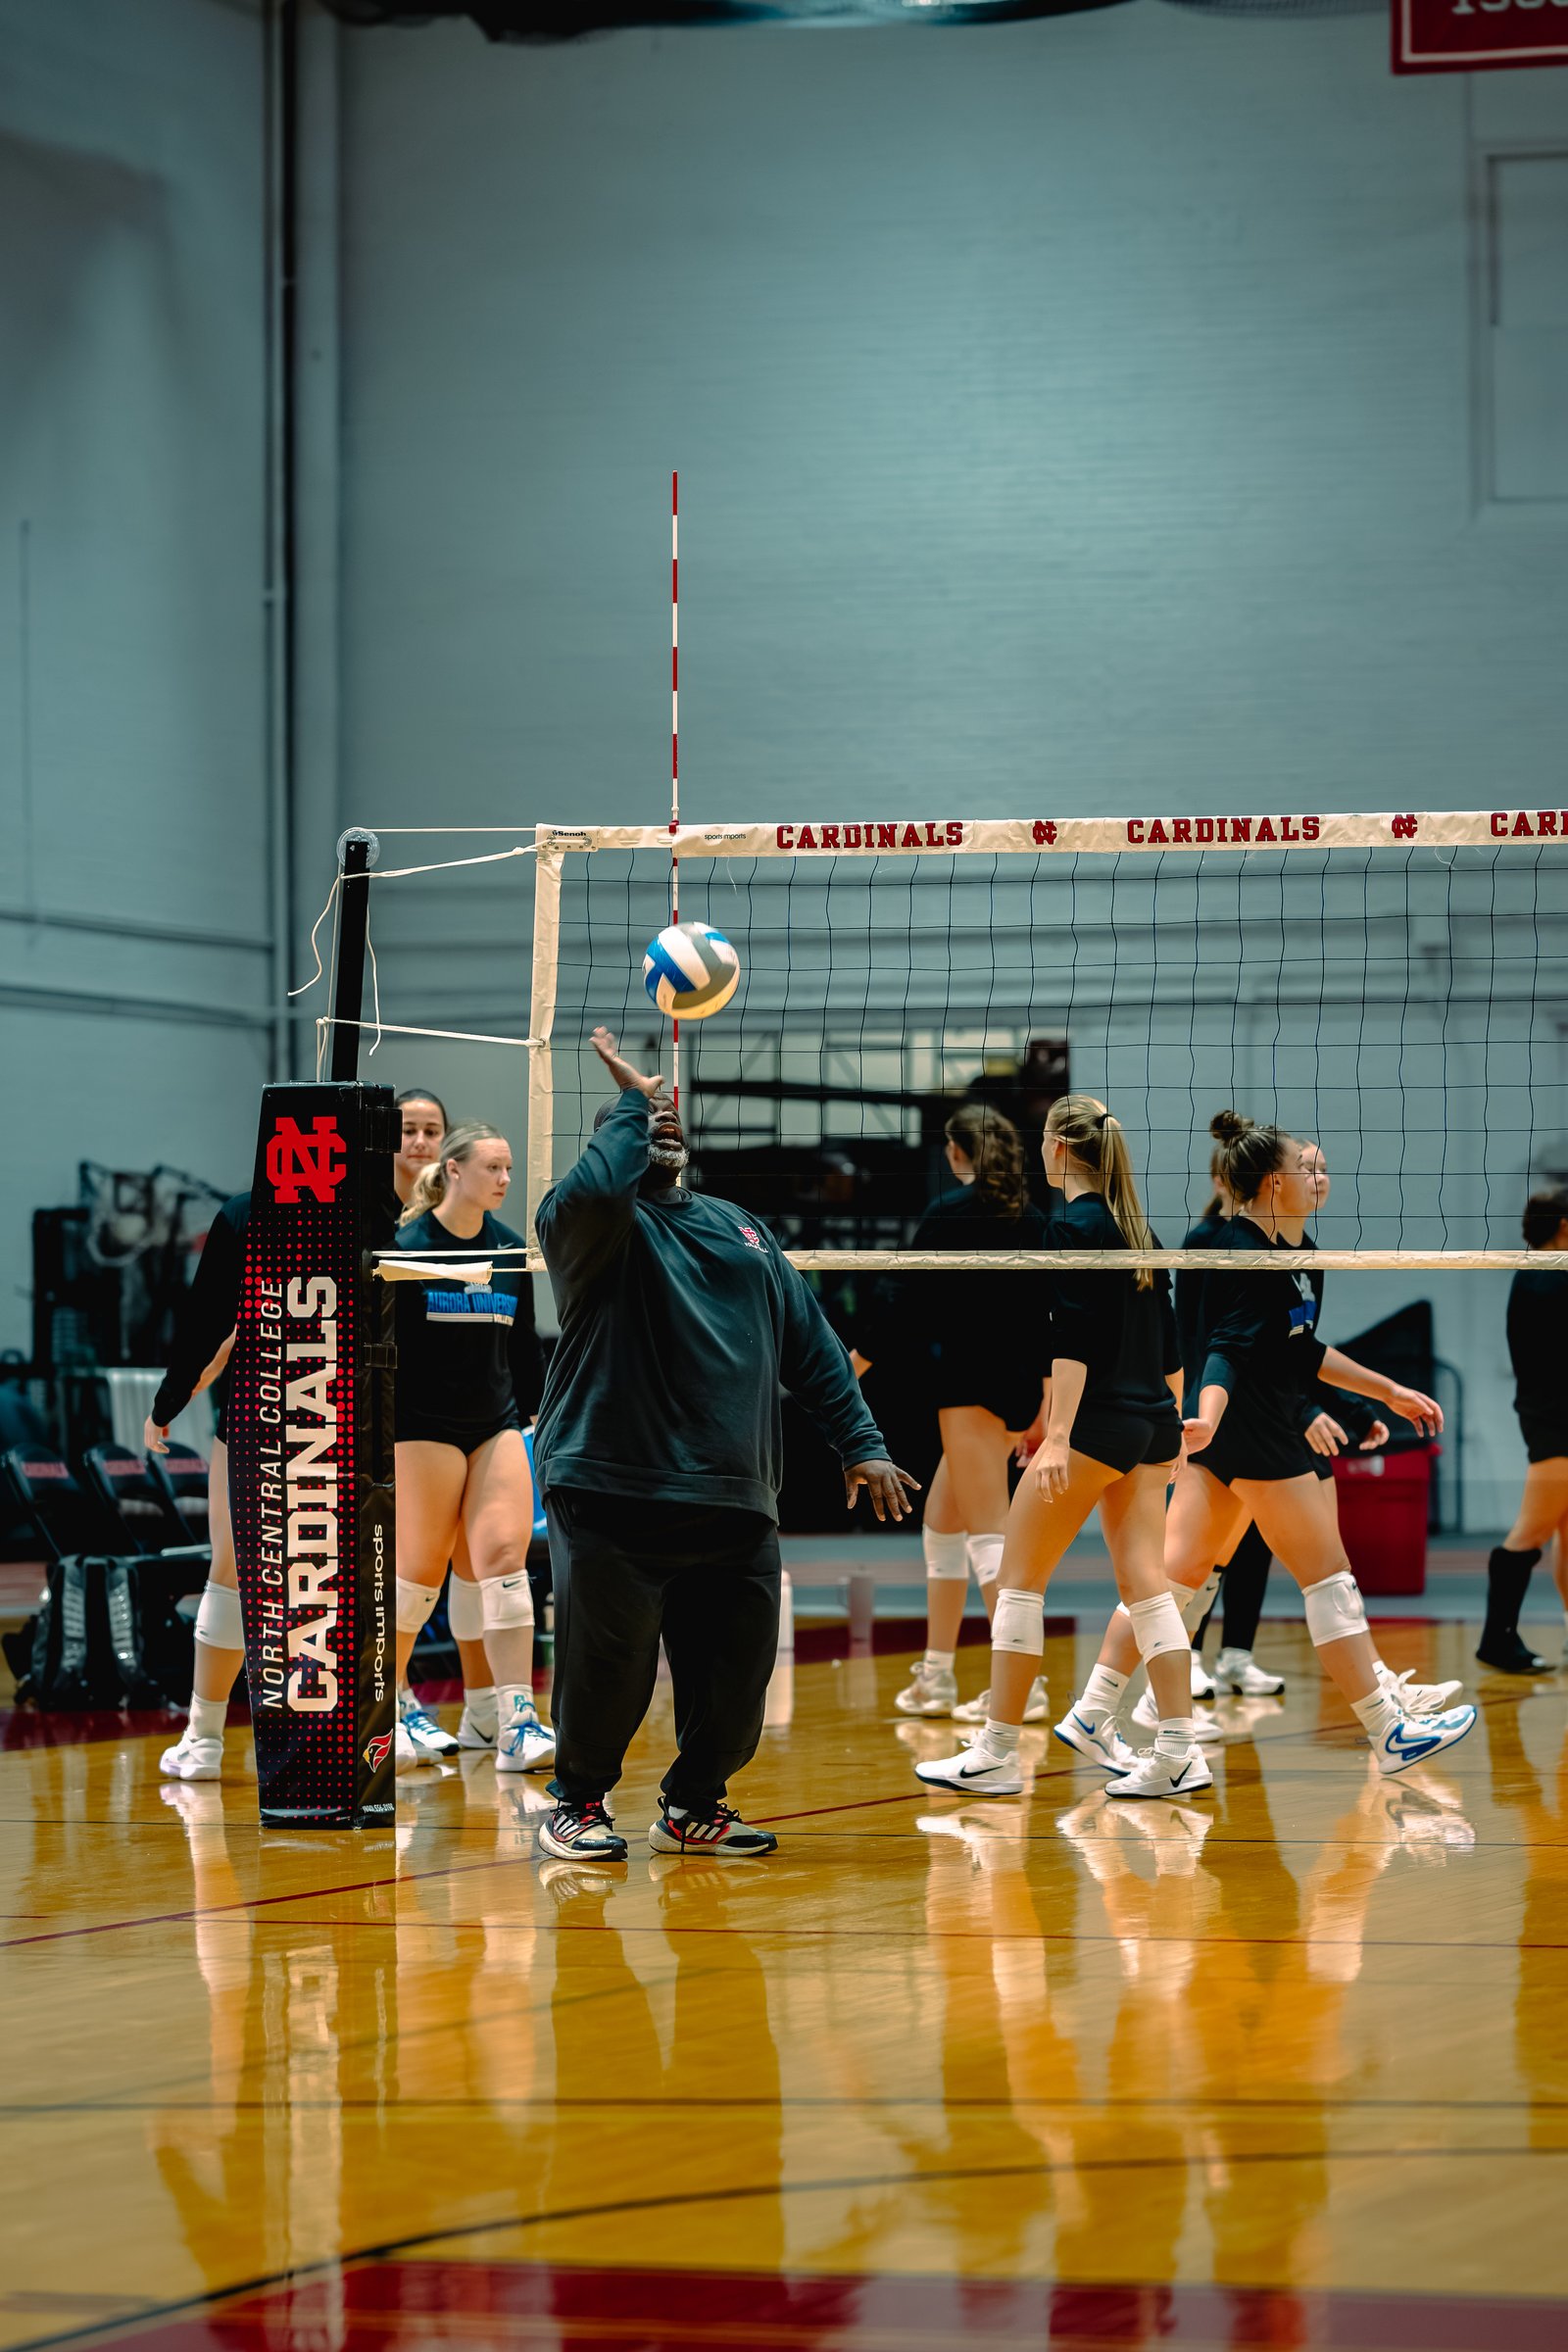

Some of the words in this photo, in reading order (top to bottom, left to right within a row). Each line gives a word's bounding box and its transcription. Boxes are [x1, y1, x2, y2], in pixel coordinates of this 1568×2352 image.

[776, 821, 963, 850] CARDINALS
[1127, 815, 1320, 844] CARDINALS
[267, 1116, 347, 1203] NC
[426, 1292, 470, 1313] AURORA
[259, 1280, 283, 1424] COLLEGE
[260, 1441, 284, 1586] CENTRAL
[285, 1276, 339, 1712] CARDINALS
[372, 1524, 384, 1602] sports
[262, 1600, 284, 1709] NORTH
[373, 1606, 385, 1702] imports
